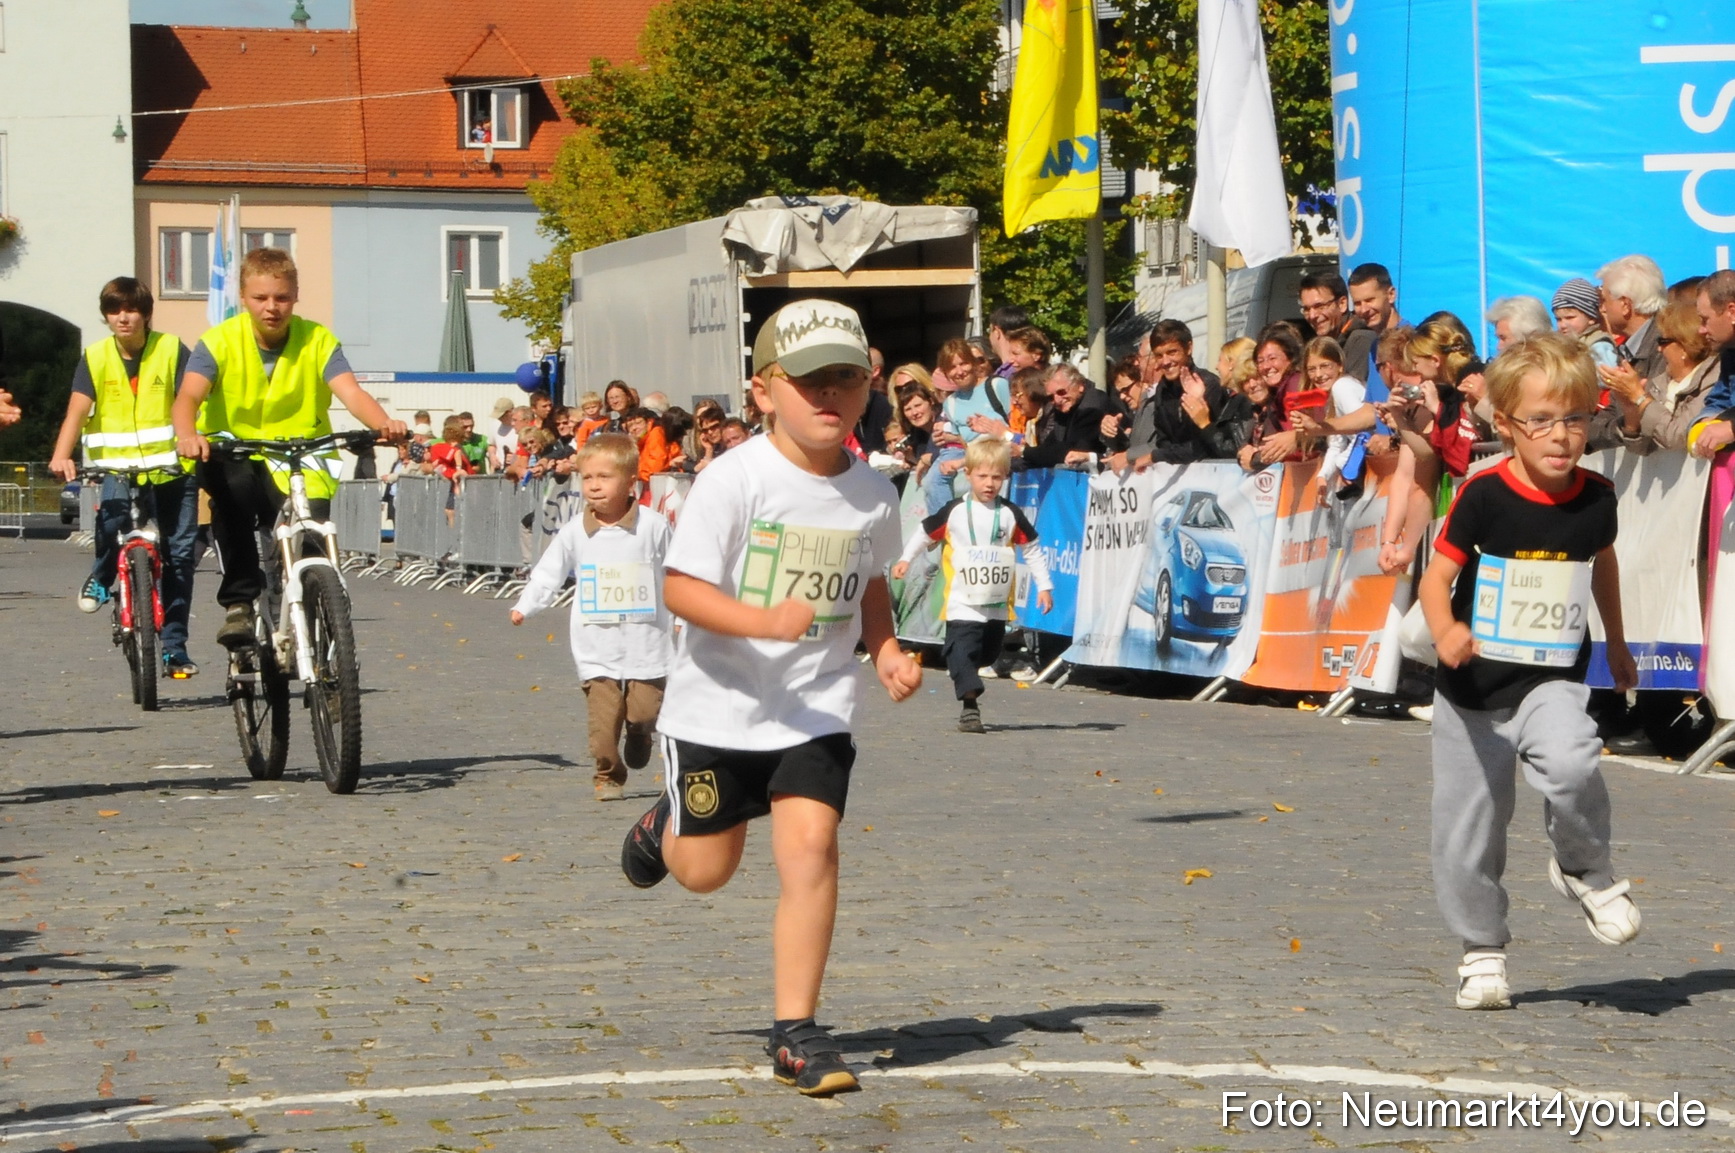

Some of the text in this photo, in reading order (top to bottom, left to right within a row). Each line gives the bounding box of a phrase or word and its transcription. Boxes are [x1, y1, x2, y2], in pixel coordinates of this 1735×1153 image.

[1119, 486, 1138, 514] SO
[780, 530, 873, 568] PHILIPP
[968, 549, 1001, 564] PAUL
[599, 568, 622, 580] Felix
[785, 567, 860, 602] 7300
[959, 565, 1010, 586] 10365
[1511, 568, 1543, 589] Luis
[601, 584, 649, 604] 7018
[1479, 592, 1495, 609] K2
[1510, 599, 1582, 631] 7292
